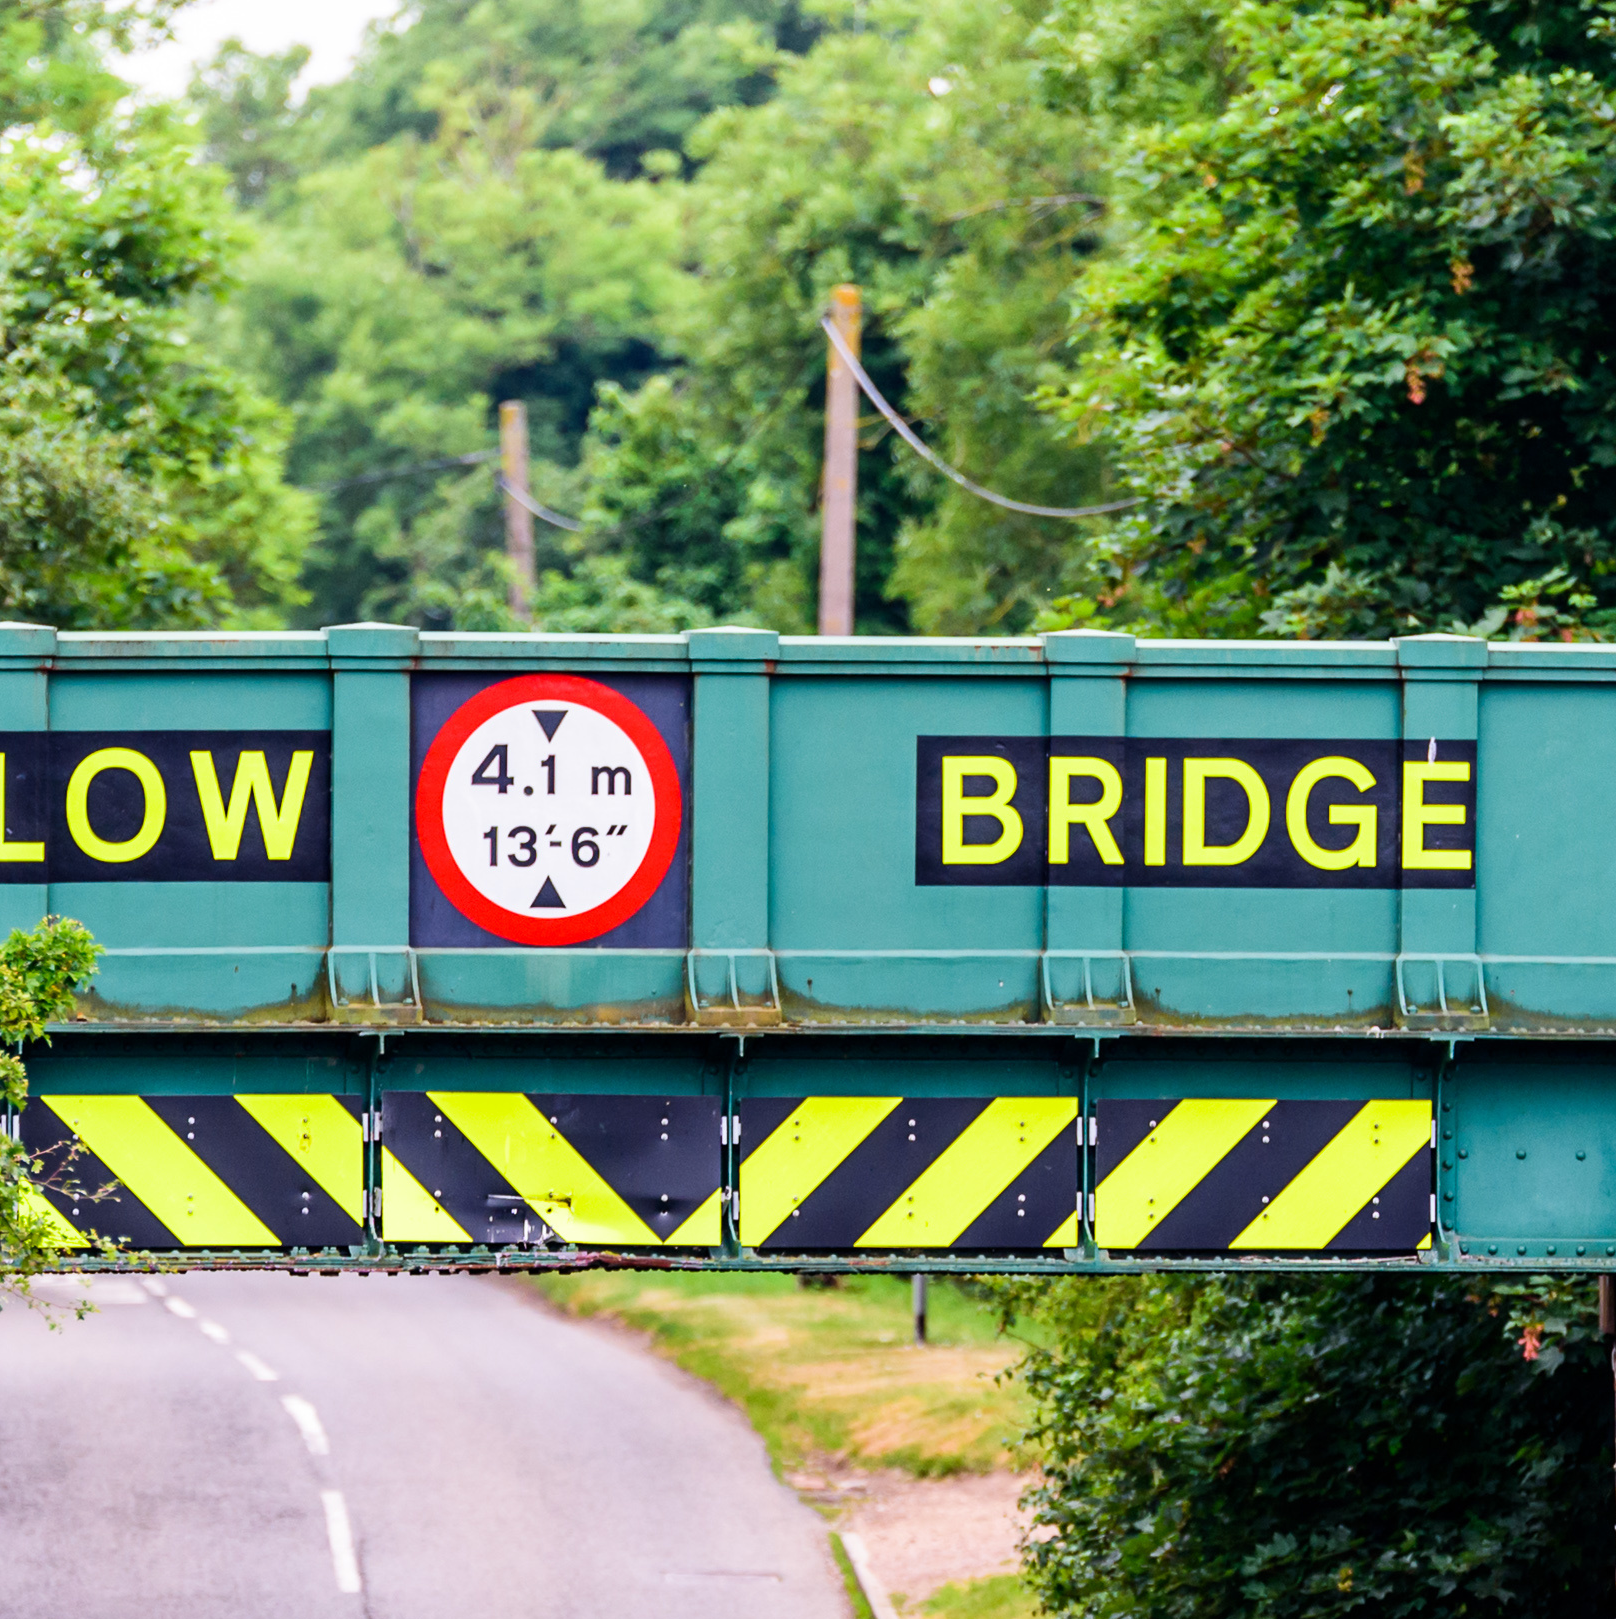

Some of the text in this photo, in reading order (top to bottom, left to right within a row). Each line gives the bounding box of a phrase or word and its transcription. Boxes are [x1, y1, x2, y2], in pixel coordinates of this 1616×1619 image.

[470, 743, 633, 797] 4.1 m
[941, 755, 1472, 871] BRIDGE
